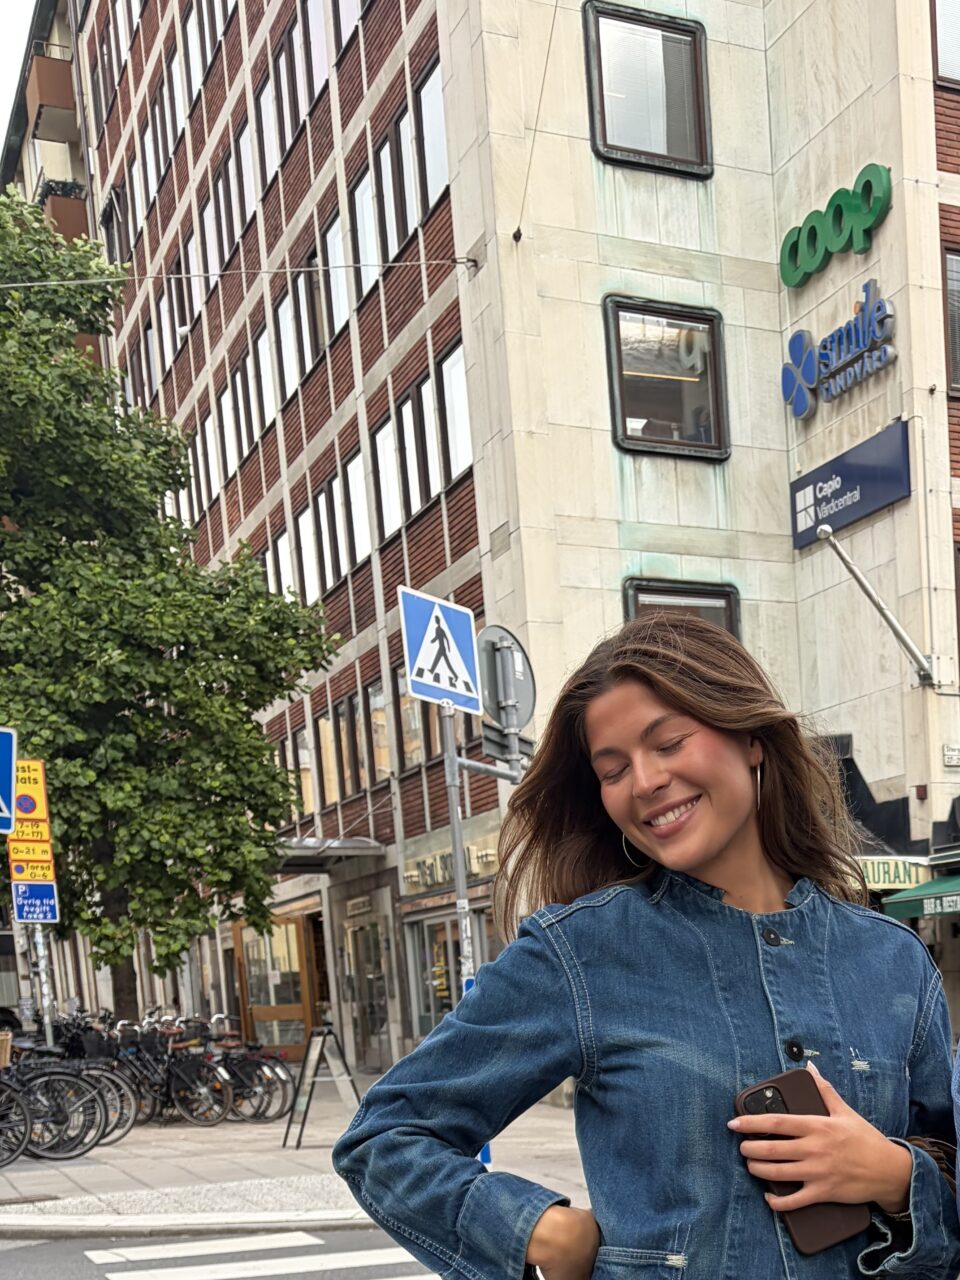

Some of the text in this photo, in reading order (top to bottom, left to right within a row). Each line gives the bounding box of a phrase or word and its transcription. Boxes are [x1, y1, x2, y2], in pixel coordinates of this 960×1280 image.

[780, 163, 892, 288] coop
[818, 279, 895, 376] smile
[820, 344, 897, 402] TANDVÅRD
[815, 474, 842, 499] Capio
[816, 485, 860, 519] Vårdcentral
